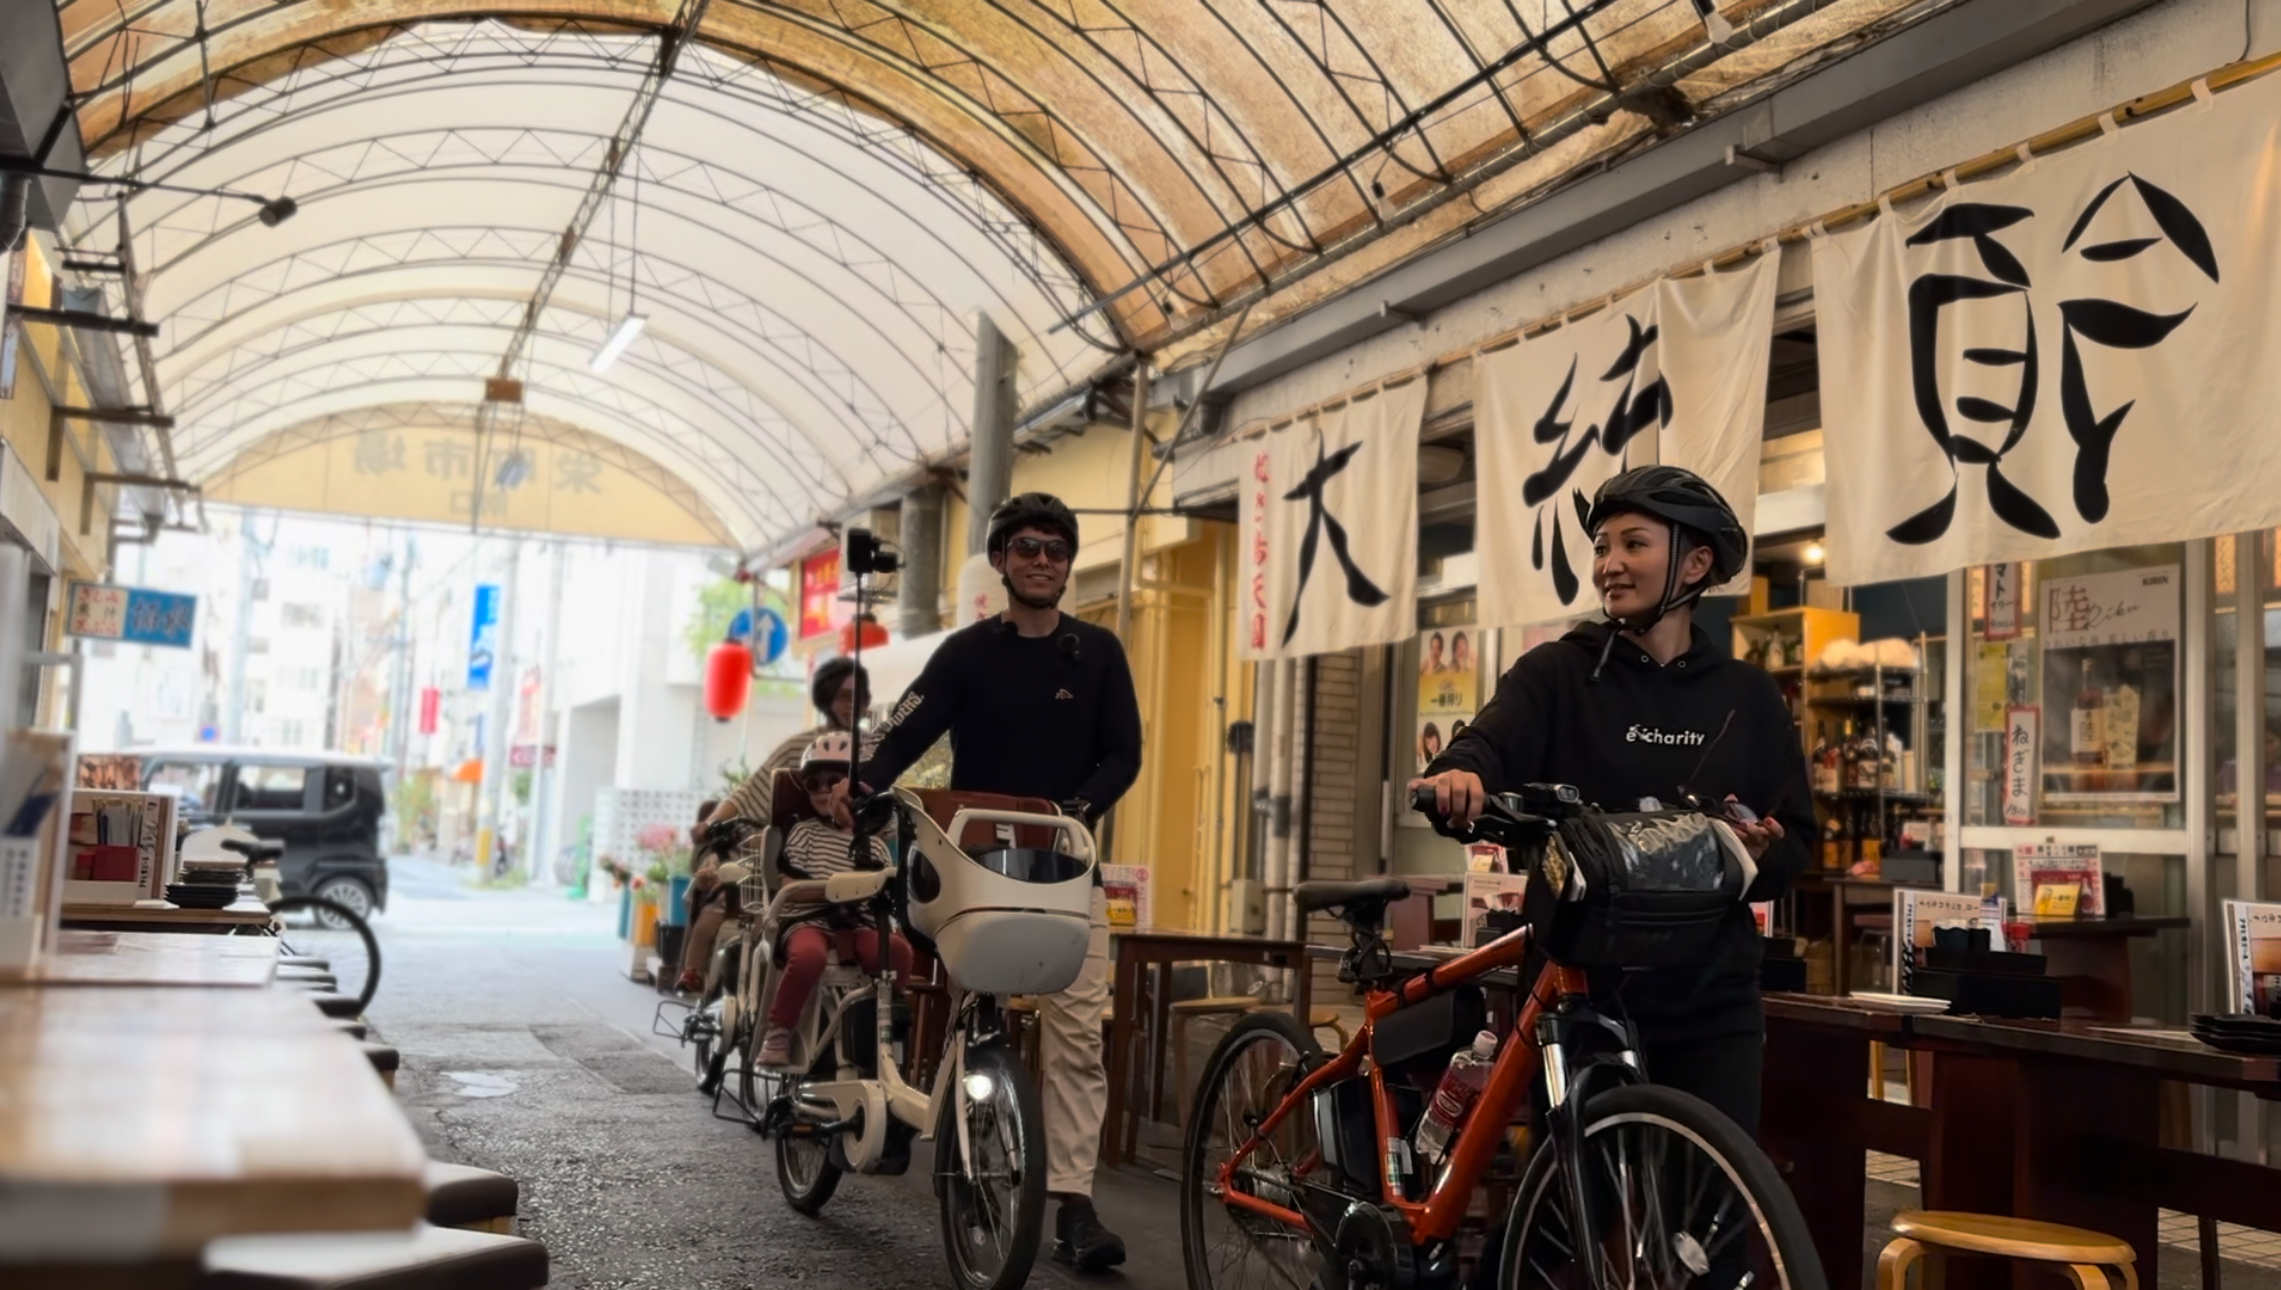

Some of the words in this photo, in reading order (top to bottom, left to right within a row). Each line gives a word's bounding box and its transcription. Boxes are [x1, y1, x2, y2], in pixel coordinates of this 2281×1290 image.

[1283, 428, 1389, 648] 大
[2142, 576, 2168, 586] KIRIN
[2047, 585, 2088, 634] 陸
[2084, 601, 2140, 628] Riku
[2012, 724, 2030, 797] ねぎま
